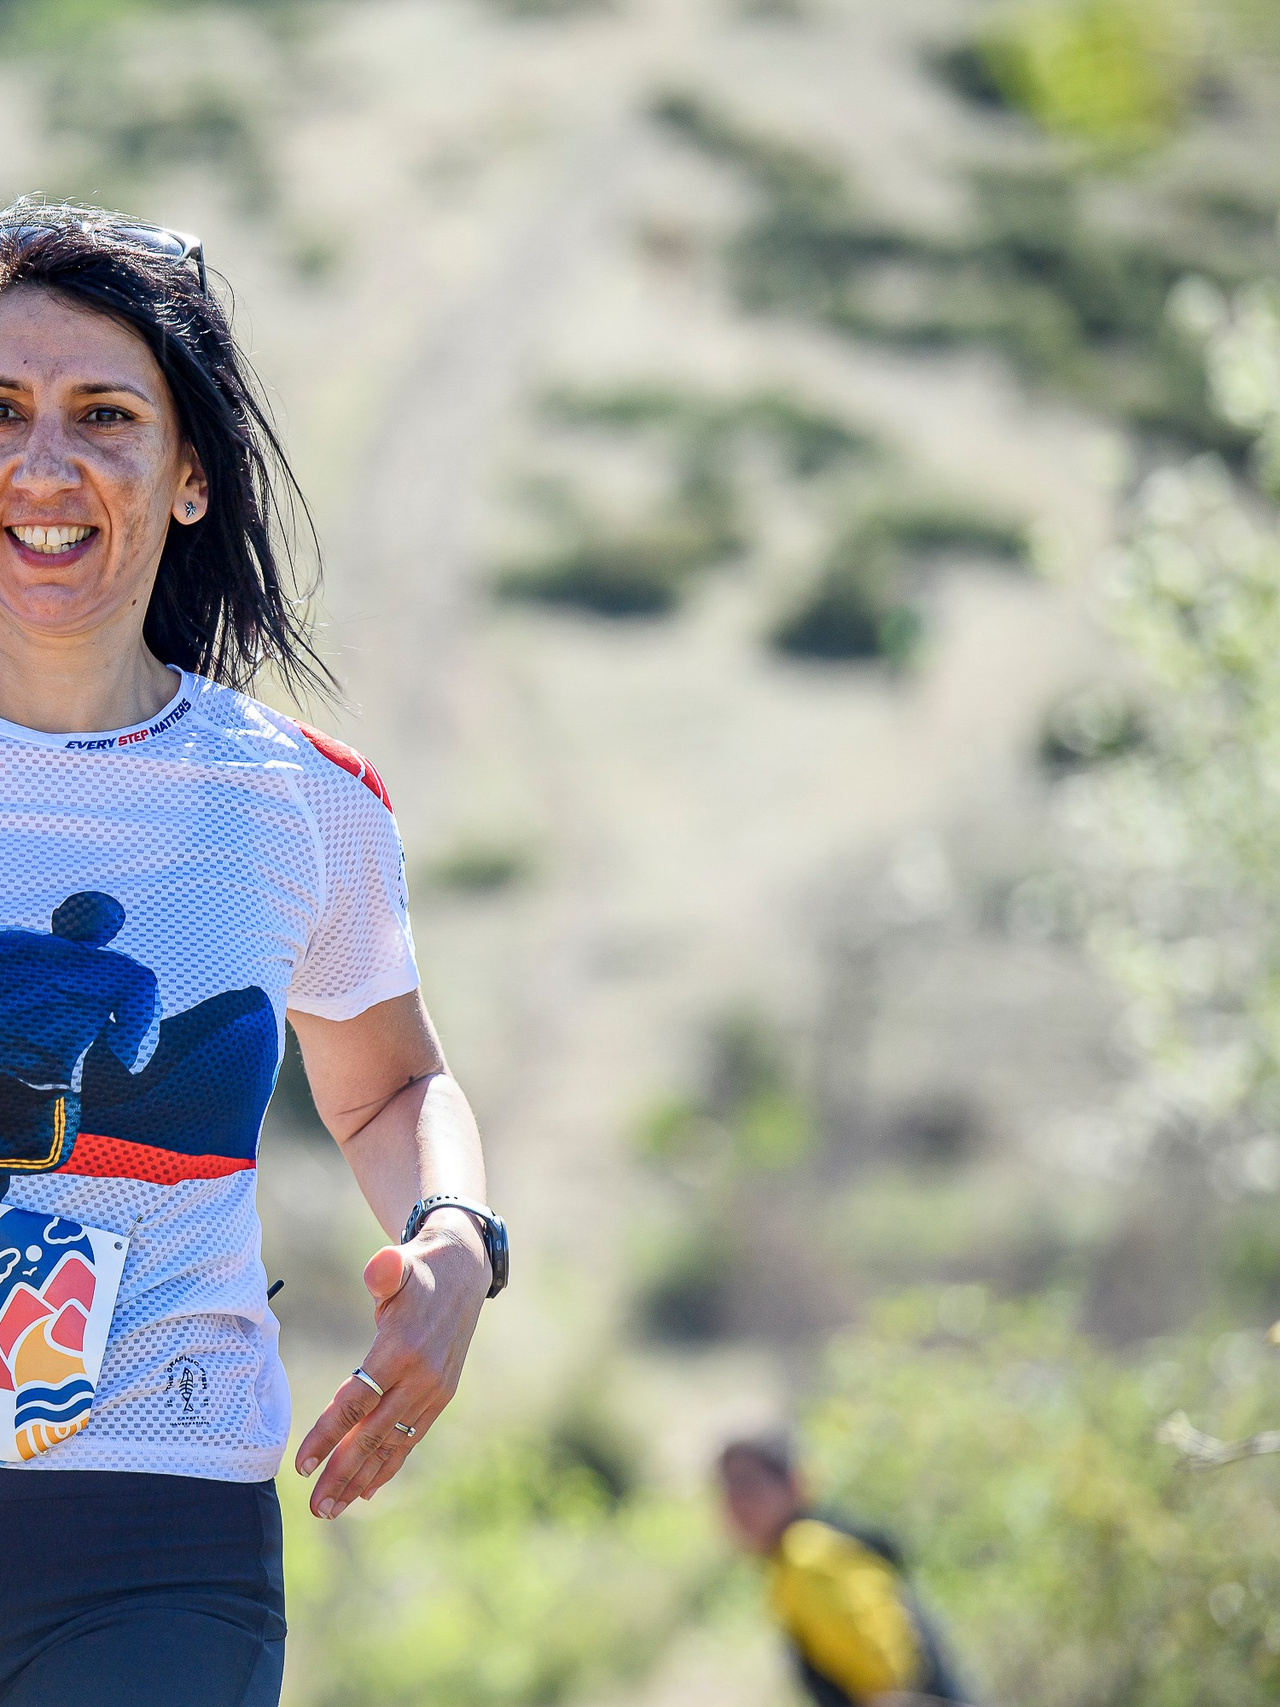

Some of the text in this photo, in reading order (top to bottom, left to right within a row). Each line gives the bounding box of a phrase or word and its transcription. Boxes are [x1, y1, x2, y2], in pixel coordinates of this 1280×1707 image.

[65, 697, 192, 750] EVERY STEP MATTERS
